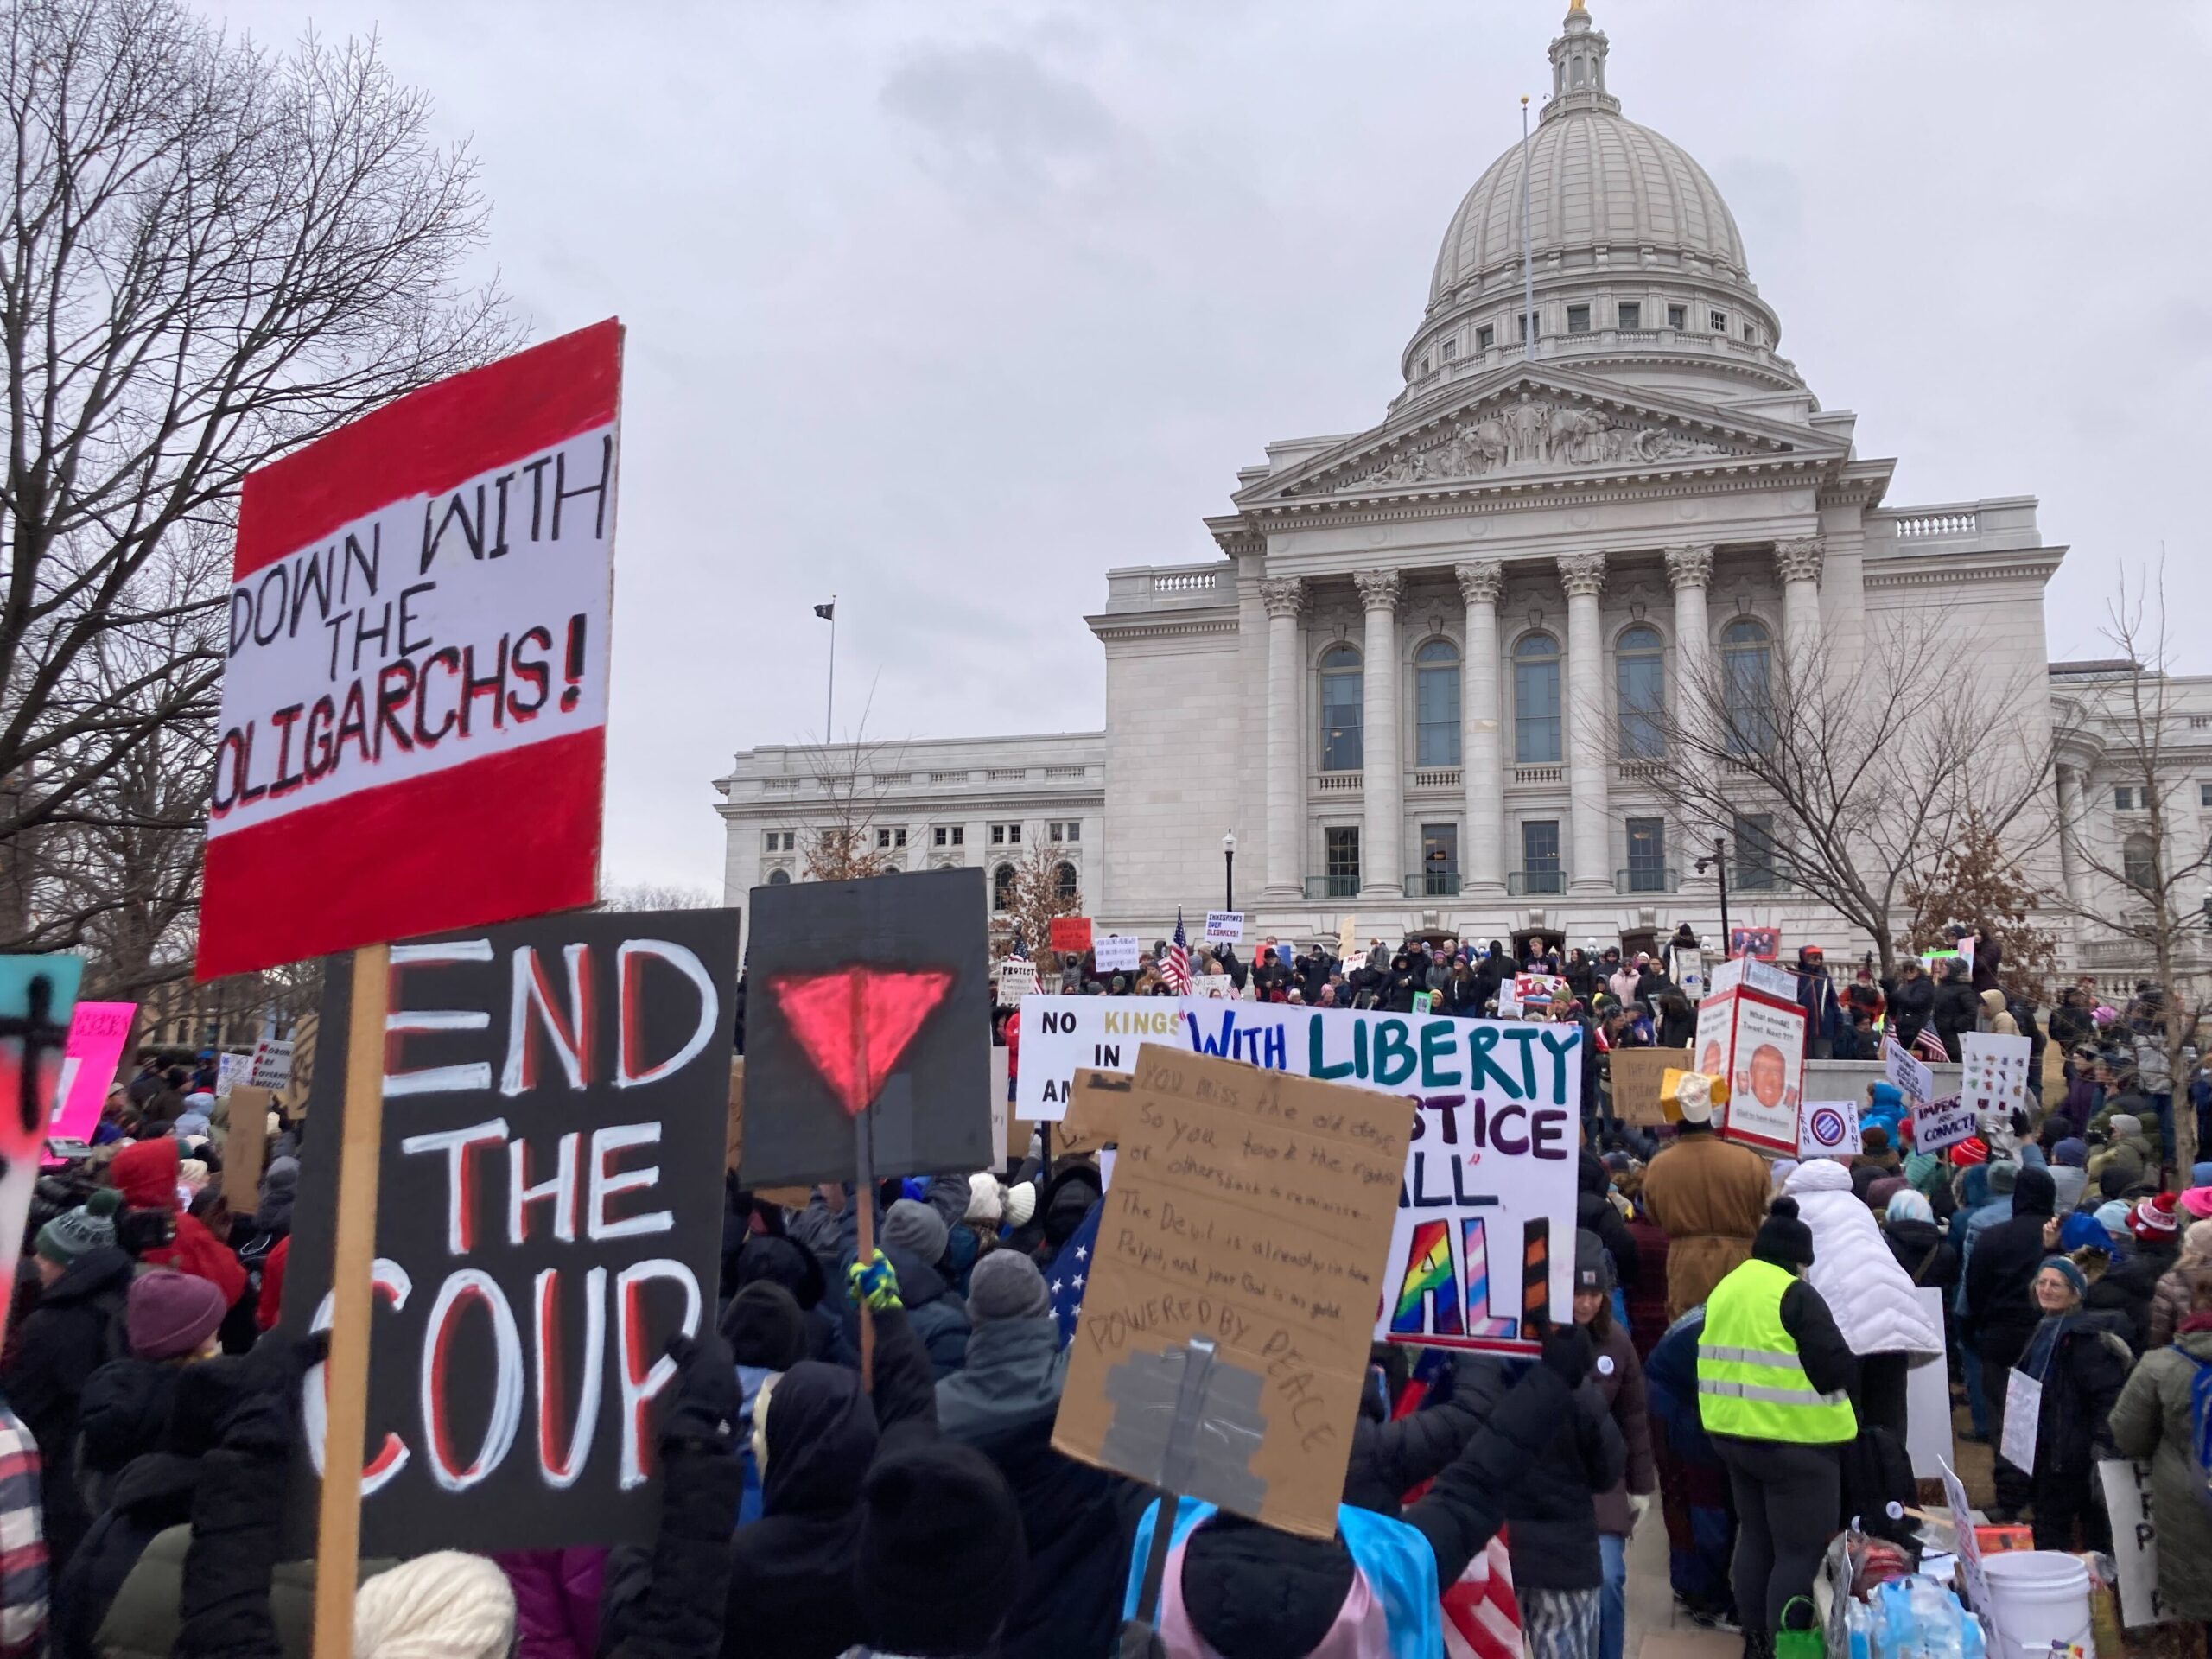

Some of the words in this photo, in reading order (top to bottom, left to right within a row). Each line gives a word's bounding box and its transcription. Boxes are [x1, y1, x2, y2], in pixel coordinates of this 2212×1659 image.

[228, 521, 382, 659] DOWN
[419, 433, 613, 576] WITH
[323, 581, 436, 683] THE
[210, 613, 588, 819] OLIGARCHS!
[1206, 929, 1239, 938] OLIGARCHS!
[1002, 966, 1035, 976] PROTECT
[382, 938, 720, 1097] END
[1042, 1011, 1077, 1034] NO
[1104, 1011, 1179, 1035] KINGS
[259, 1043, 290, 1056] MORON
[1095, 1044, 1120, 1067] IN
[1309, 1014, 1580, 1105] LIBERTY
[1141, 1060, 1185, 1092] YOU
[1256, 1090, 1298, 1120] the
[1919, 1096, 1961, 1120] IMPEAC
[1140, 1102, 1164, 1128] So
[1166, 1117, 1217, 1152] you
[1242, 1129, 1297, 1160] took
[1310, 1146, 1342, 1173] the
[1409, 1094, 1567, 1160] STICE
[1800, 1111, 1810, 1145] RON
[1847, 1103, 1859, 1153] FRONT
[1924, 1112, 1975, 1141] CONVICT!
[402, 1116, 675, 1255] THE
[1118, 1188, 1152, 1218] The
[1160, 1201, 1214, 1241] Devil
[1253, 1239, 1325, 1275] already
[1172, 1257, 1198, 1275] and
[302, 1256, 703, 1497] COUP
[1087, 1294, 1211, 1355] POWERED
[1218, 1305, 1251, 1345] BY
[1262, 1329, 1337, 1453] PEACE
